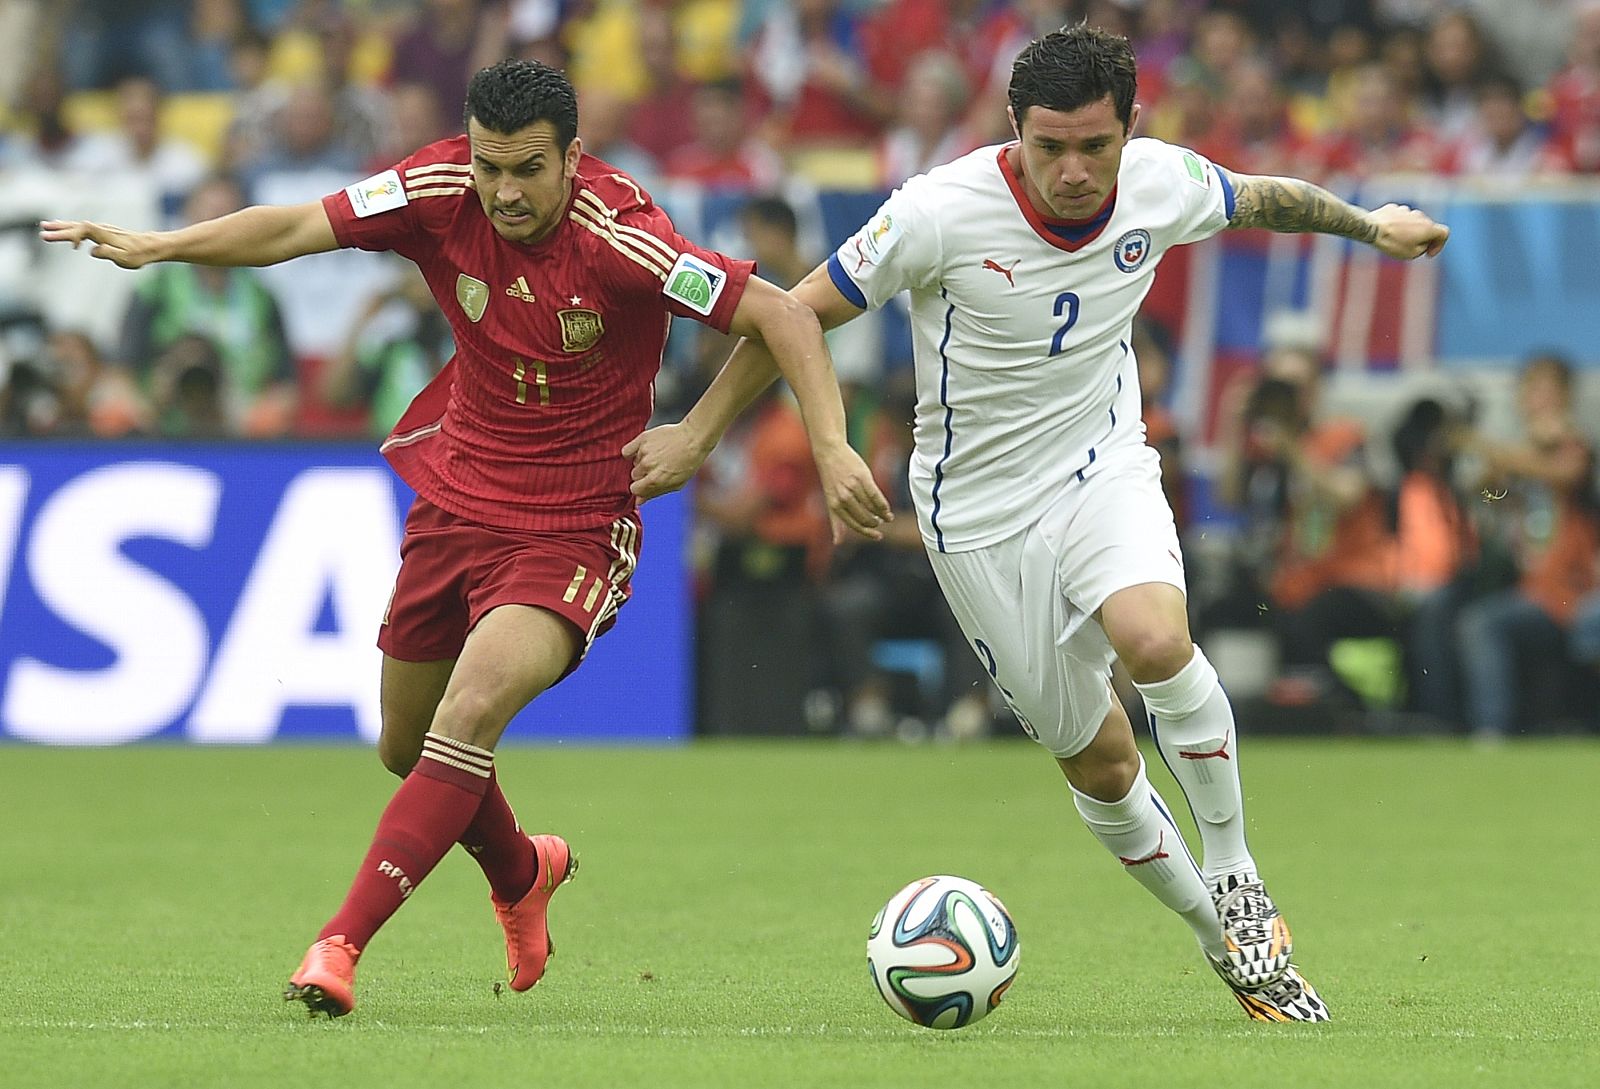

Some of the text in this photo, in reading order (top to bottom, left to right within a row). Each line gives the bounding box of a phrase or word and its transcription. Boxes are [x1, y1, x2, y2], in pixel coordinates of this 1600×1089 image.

[505, 287, 536, 303] addas
[1048, 291, 1080, 357] 2
[511, 356, 551, 406] 11
[562, 564, 603, 613] 11
